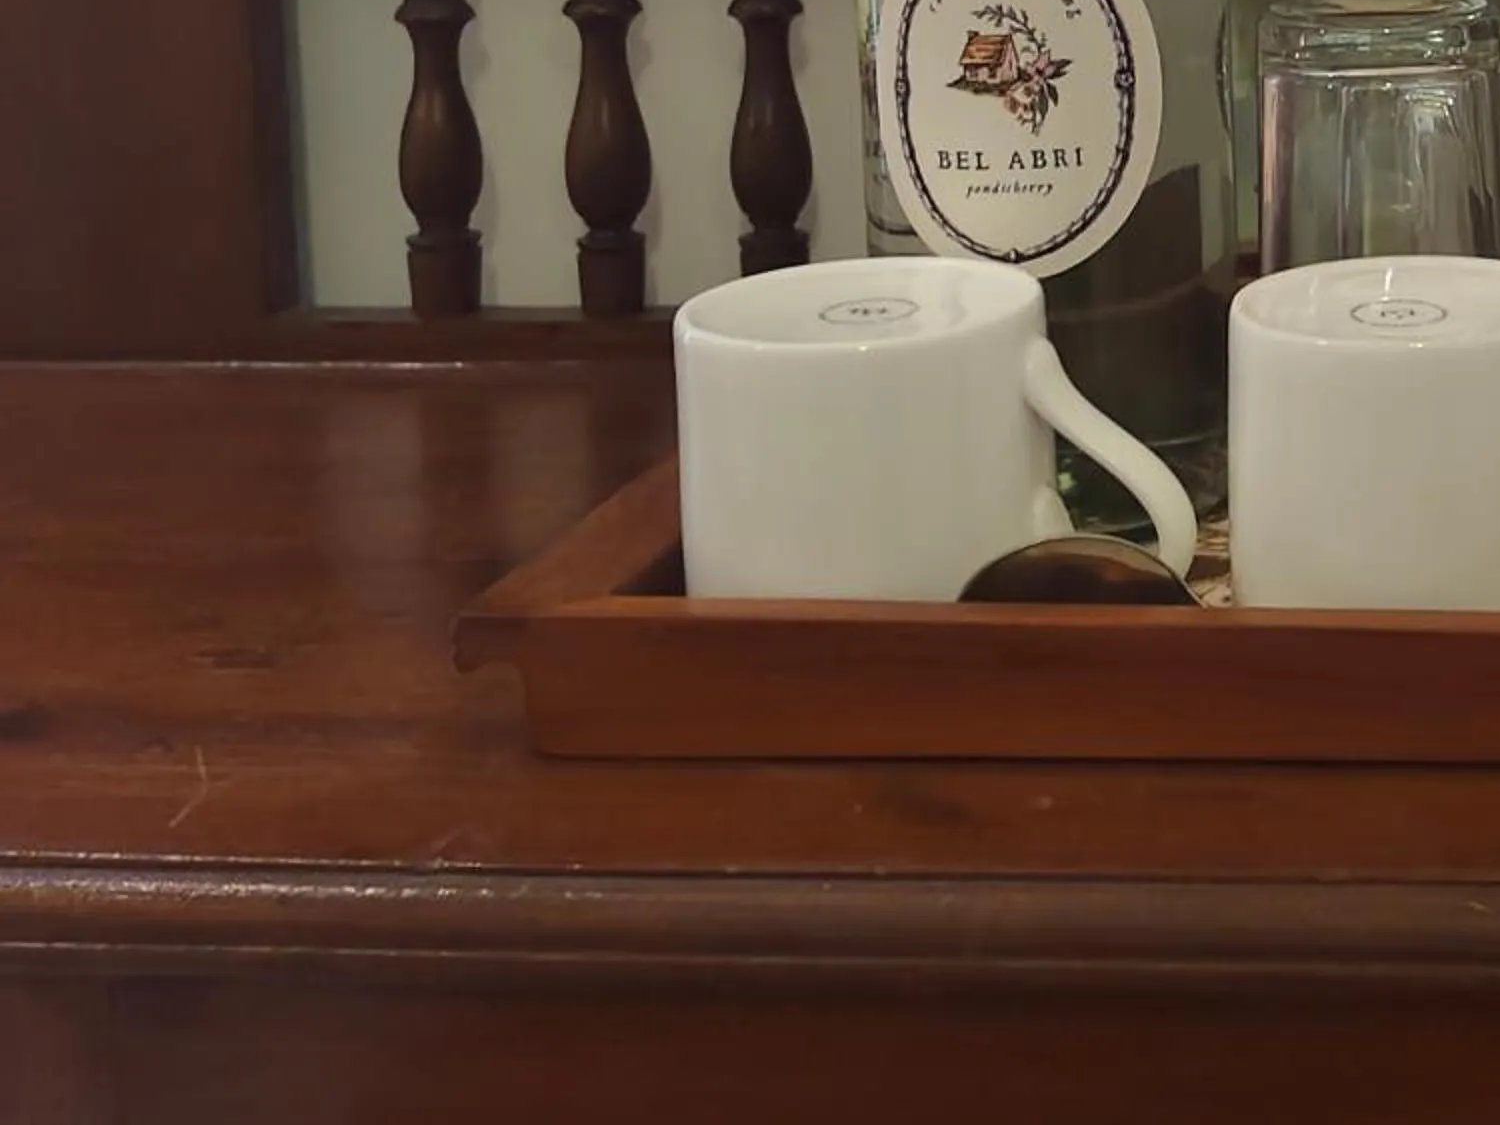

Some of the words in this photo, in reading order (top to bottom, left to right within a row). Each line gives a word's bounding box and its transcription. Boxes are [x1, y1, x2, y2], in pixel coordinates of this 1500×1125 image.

[937, 150, 991, 171] BEL
[1008, 147, 1085, 171] ABRI
[965, 181, 1055, 199] pondicherry
